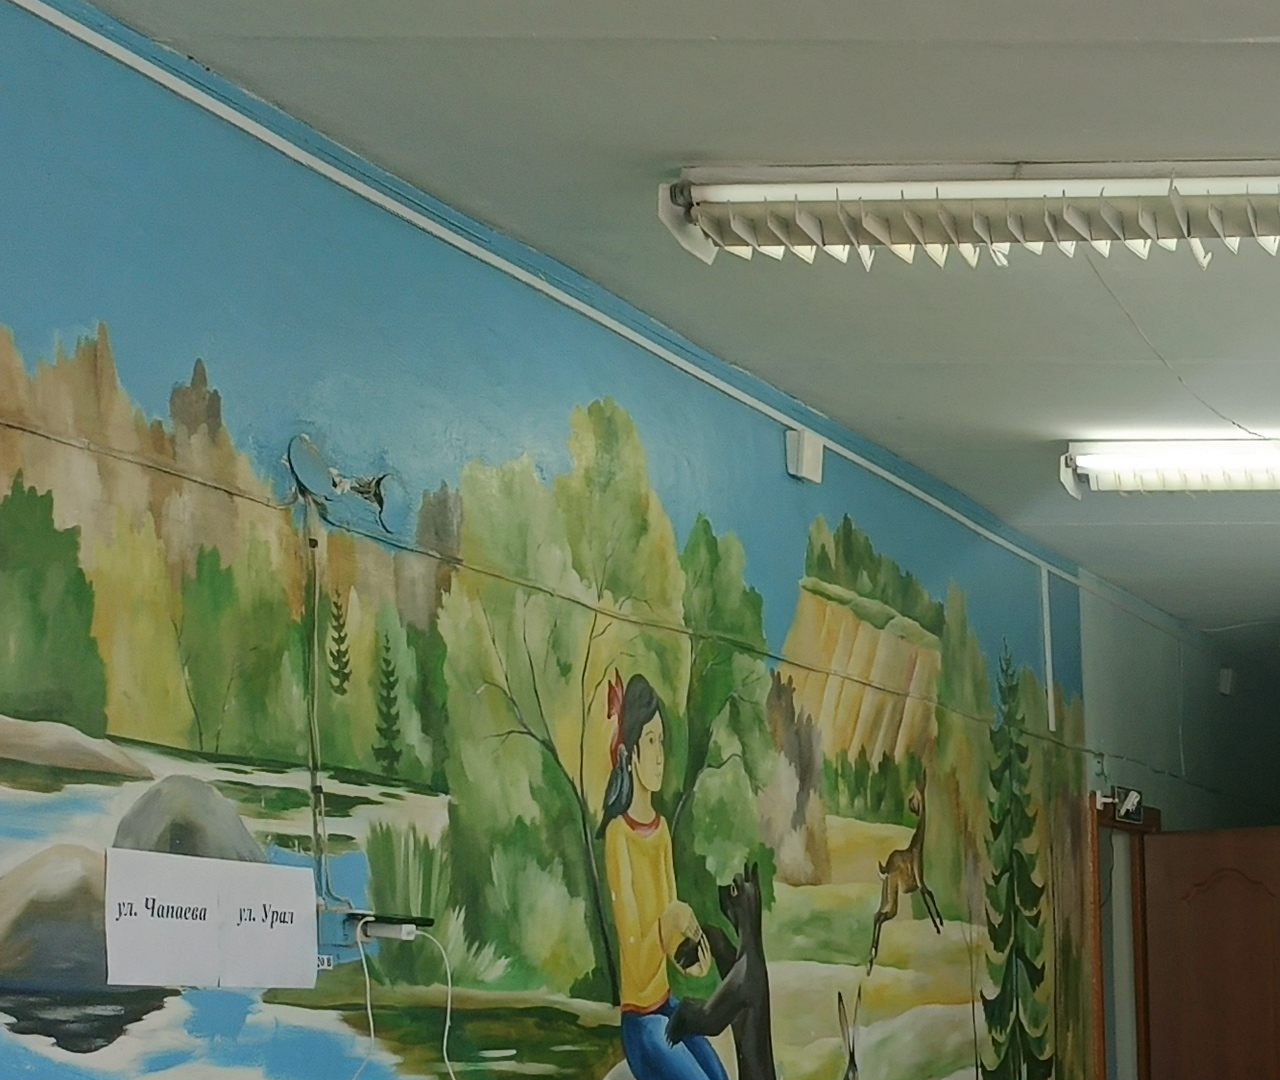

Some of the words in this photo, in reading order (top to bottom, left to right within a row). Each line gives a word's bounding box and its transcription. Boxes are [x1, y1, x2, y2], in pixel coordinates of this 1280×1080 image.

[115, 900, 137, 921] ул.
[145, 897, 207, 921] Чапаева
[237, 906, 256, 926] ул.
[262, 903, 294, 928] Урал
